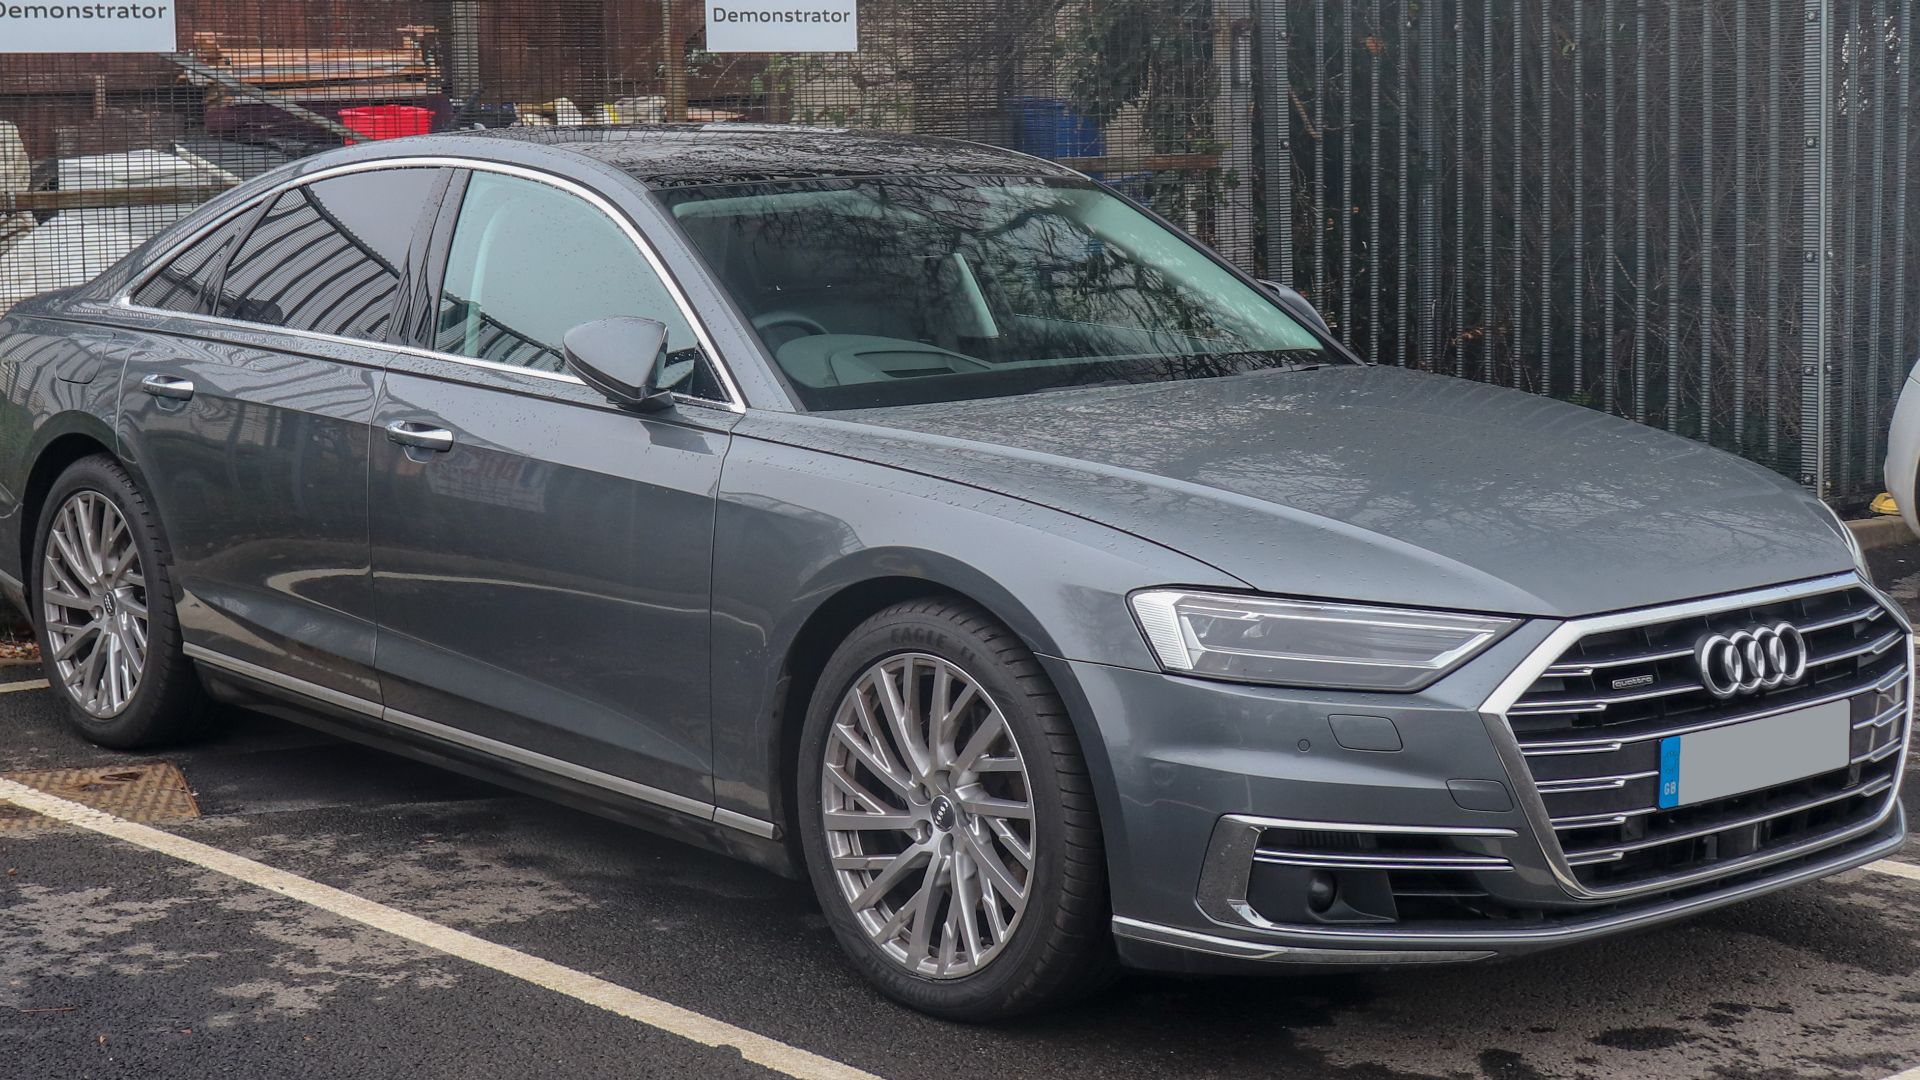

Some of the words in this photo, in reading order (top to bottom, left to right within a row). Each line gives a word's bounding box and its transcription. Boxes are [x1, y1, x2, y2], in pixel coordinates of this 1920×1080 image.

[713, 7, 850, 23] Demonstrator
[889, 627, 948, 648] EAGLE
[1614, 676, 1652, 688] quattro
[1664, 781, 1676, 795] GB
